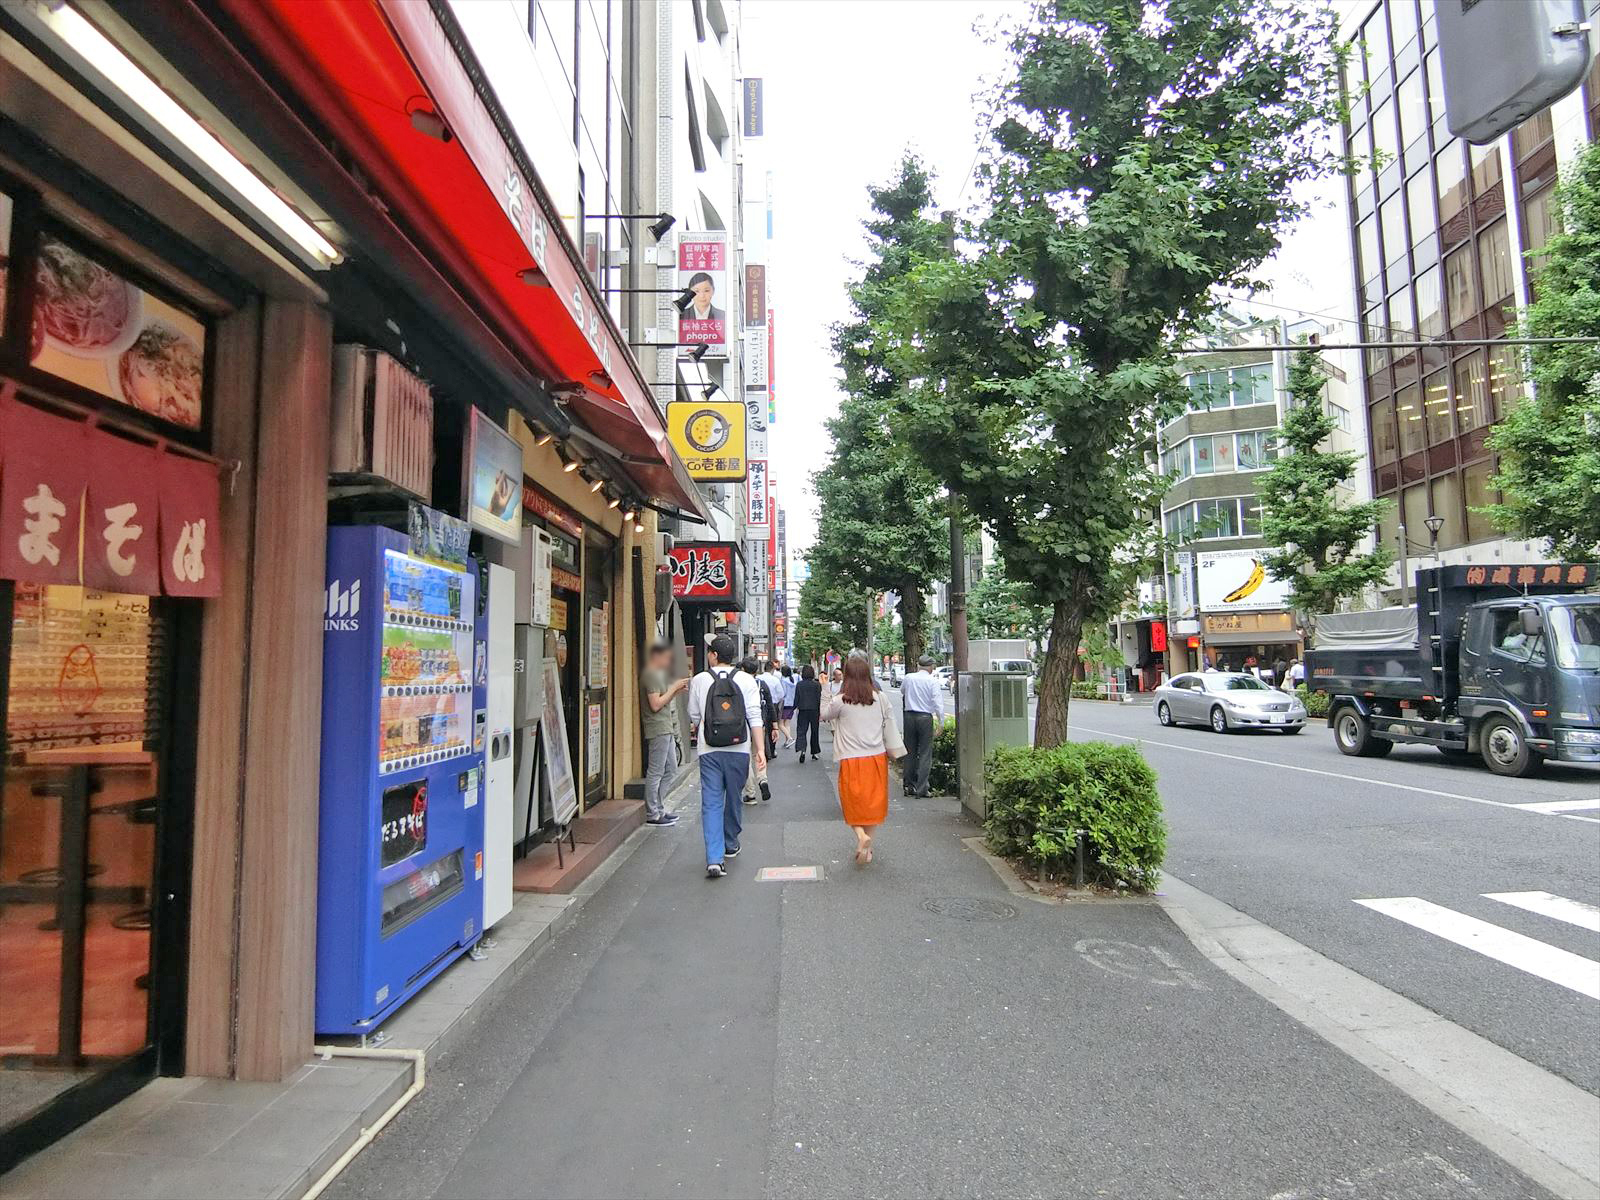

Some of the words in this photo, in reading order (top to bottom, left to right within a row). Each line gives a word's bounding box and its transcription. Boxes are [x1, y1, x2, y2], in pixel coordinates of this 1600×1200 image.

[686, 332, 718, 342] phopro
[751, 566, 760, 593] トライ
